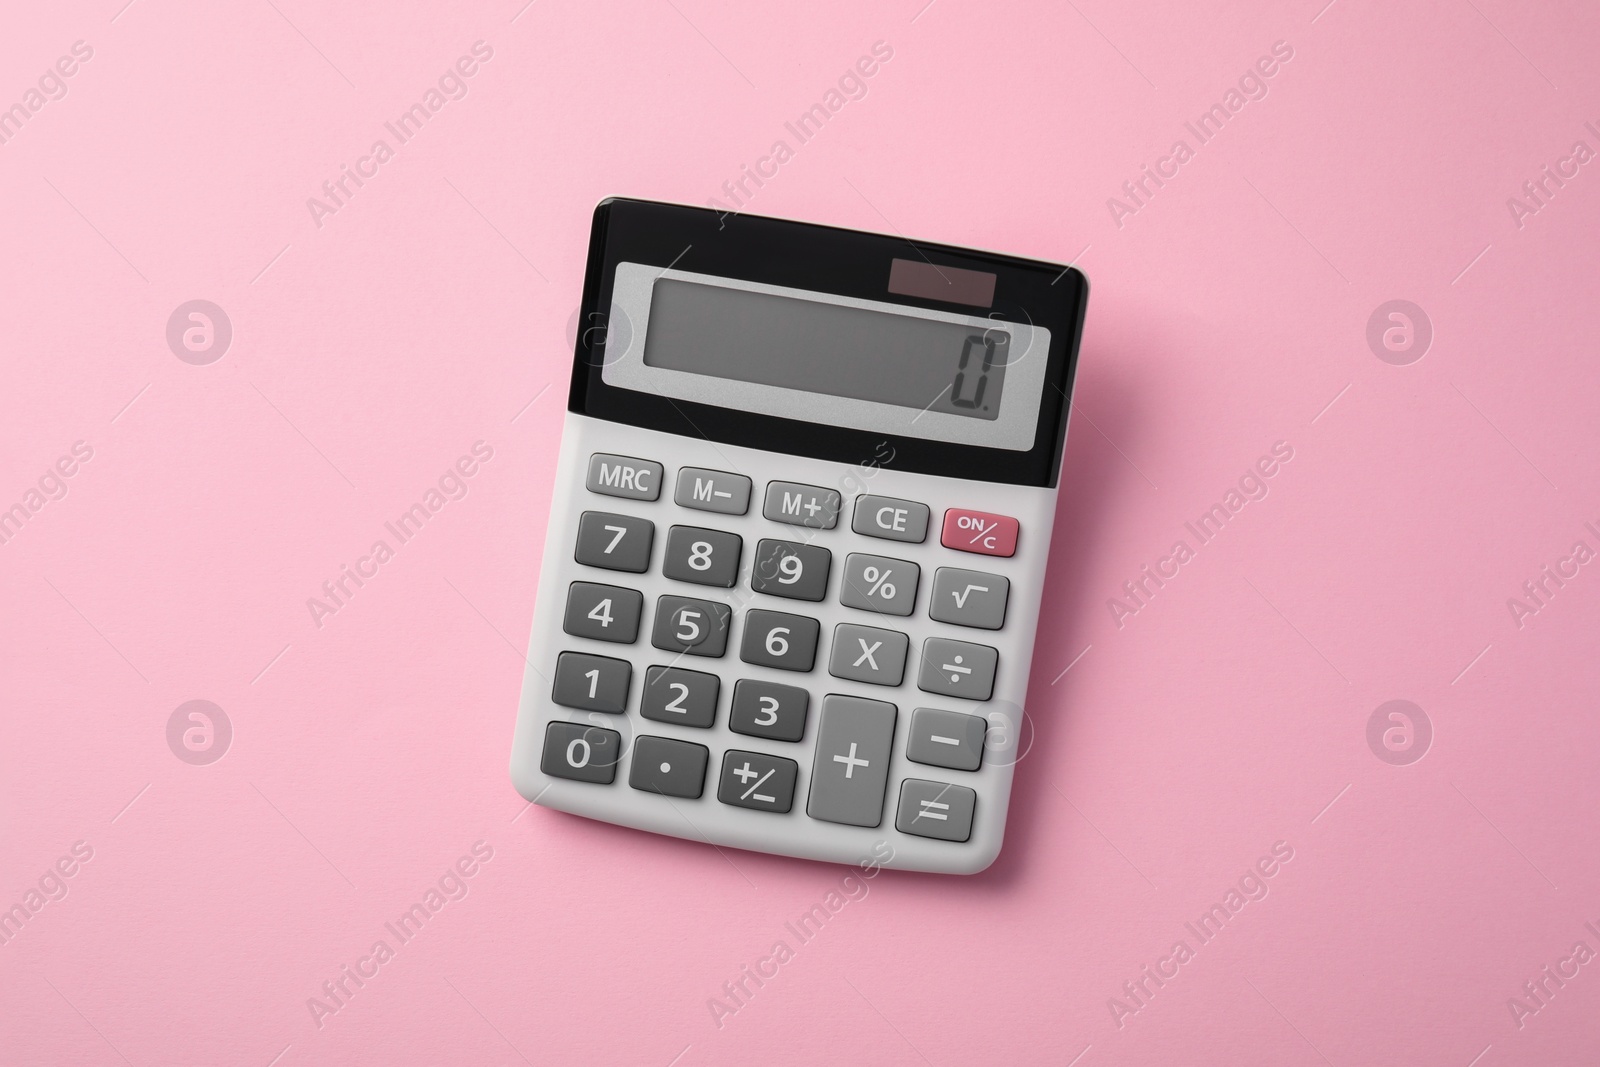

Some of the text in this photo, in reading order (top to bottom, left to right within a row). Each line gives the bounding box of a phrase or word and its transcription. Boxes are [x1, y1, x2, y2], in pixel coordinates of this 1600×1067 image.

[598, 462, 651, 492] MRC
[781, 491, 822, 517] M+
[875, 506, 909, 532] CE
[603, 524, 627, 554] 7
[687, 541, 714, 571] 8
[778, 555, 803, 585] 9
[863, 566, 896, 600] %
[587, 598, 614, 628] 4
[676, 610, 701, 641] 5
[765, 626, 791, 656] 6
[584, 669, 600, 699] 1
[664, 682, 689, 714] 2
[754, 696, 780, 726] 3
[566, 738, 591, 768] 0
[833, 742, 870, 779] +
[918, 799, 950, 821] =
